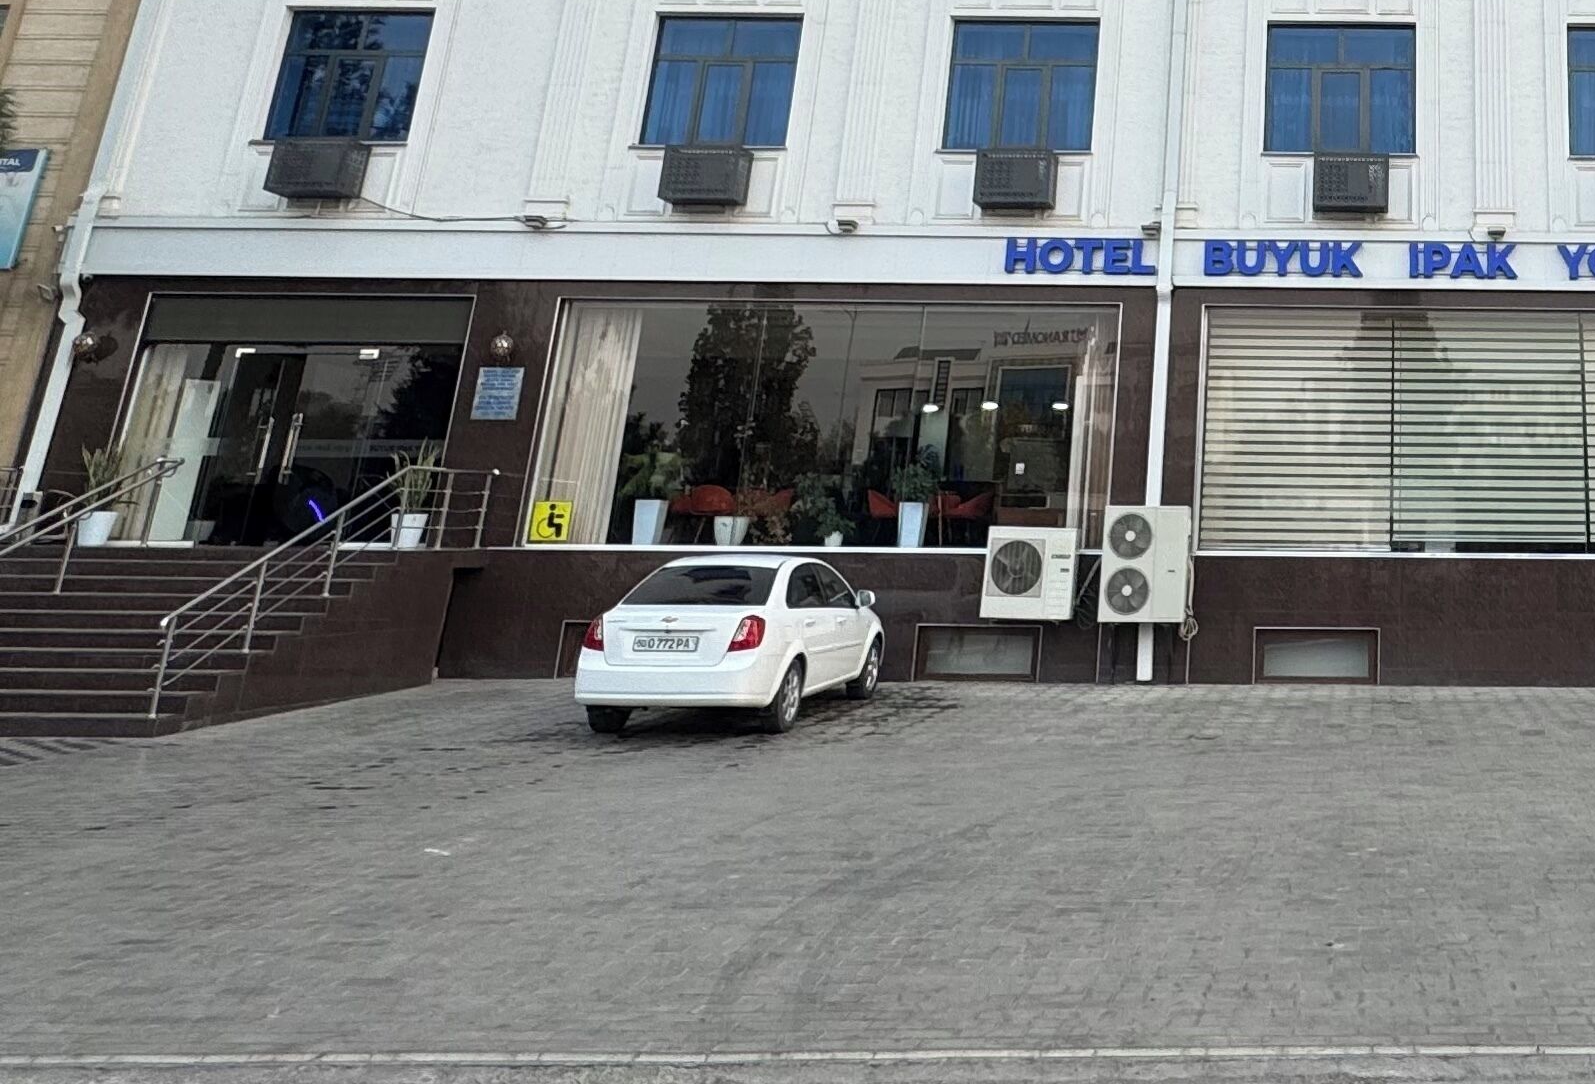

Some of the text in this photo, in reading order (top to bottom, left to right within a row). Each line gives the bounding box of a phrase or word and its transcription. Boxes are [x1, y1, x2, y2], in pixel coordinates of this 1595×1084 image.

[1004, 237, 1157, 275] HOTEL
[1203, 240, 1364, 277] BUYUK
[1409, 241, 1518, 279] IPAK
[656, 638, 675, 649] 772
